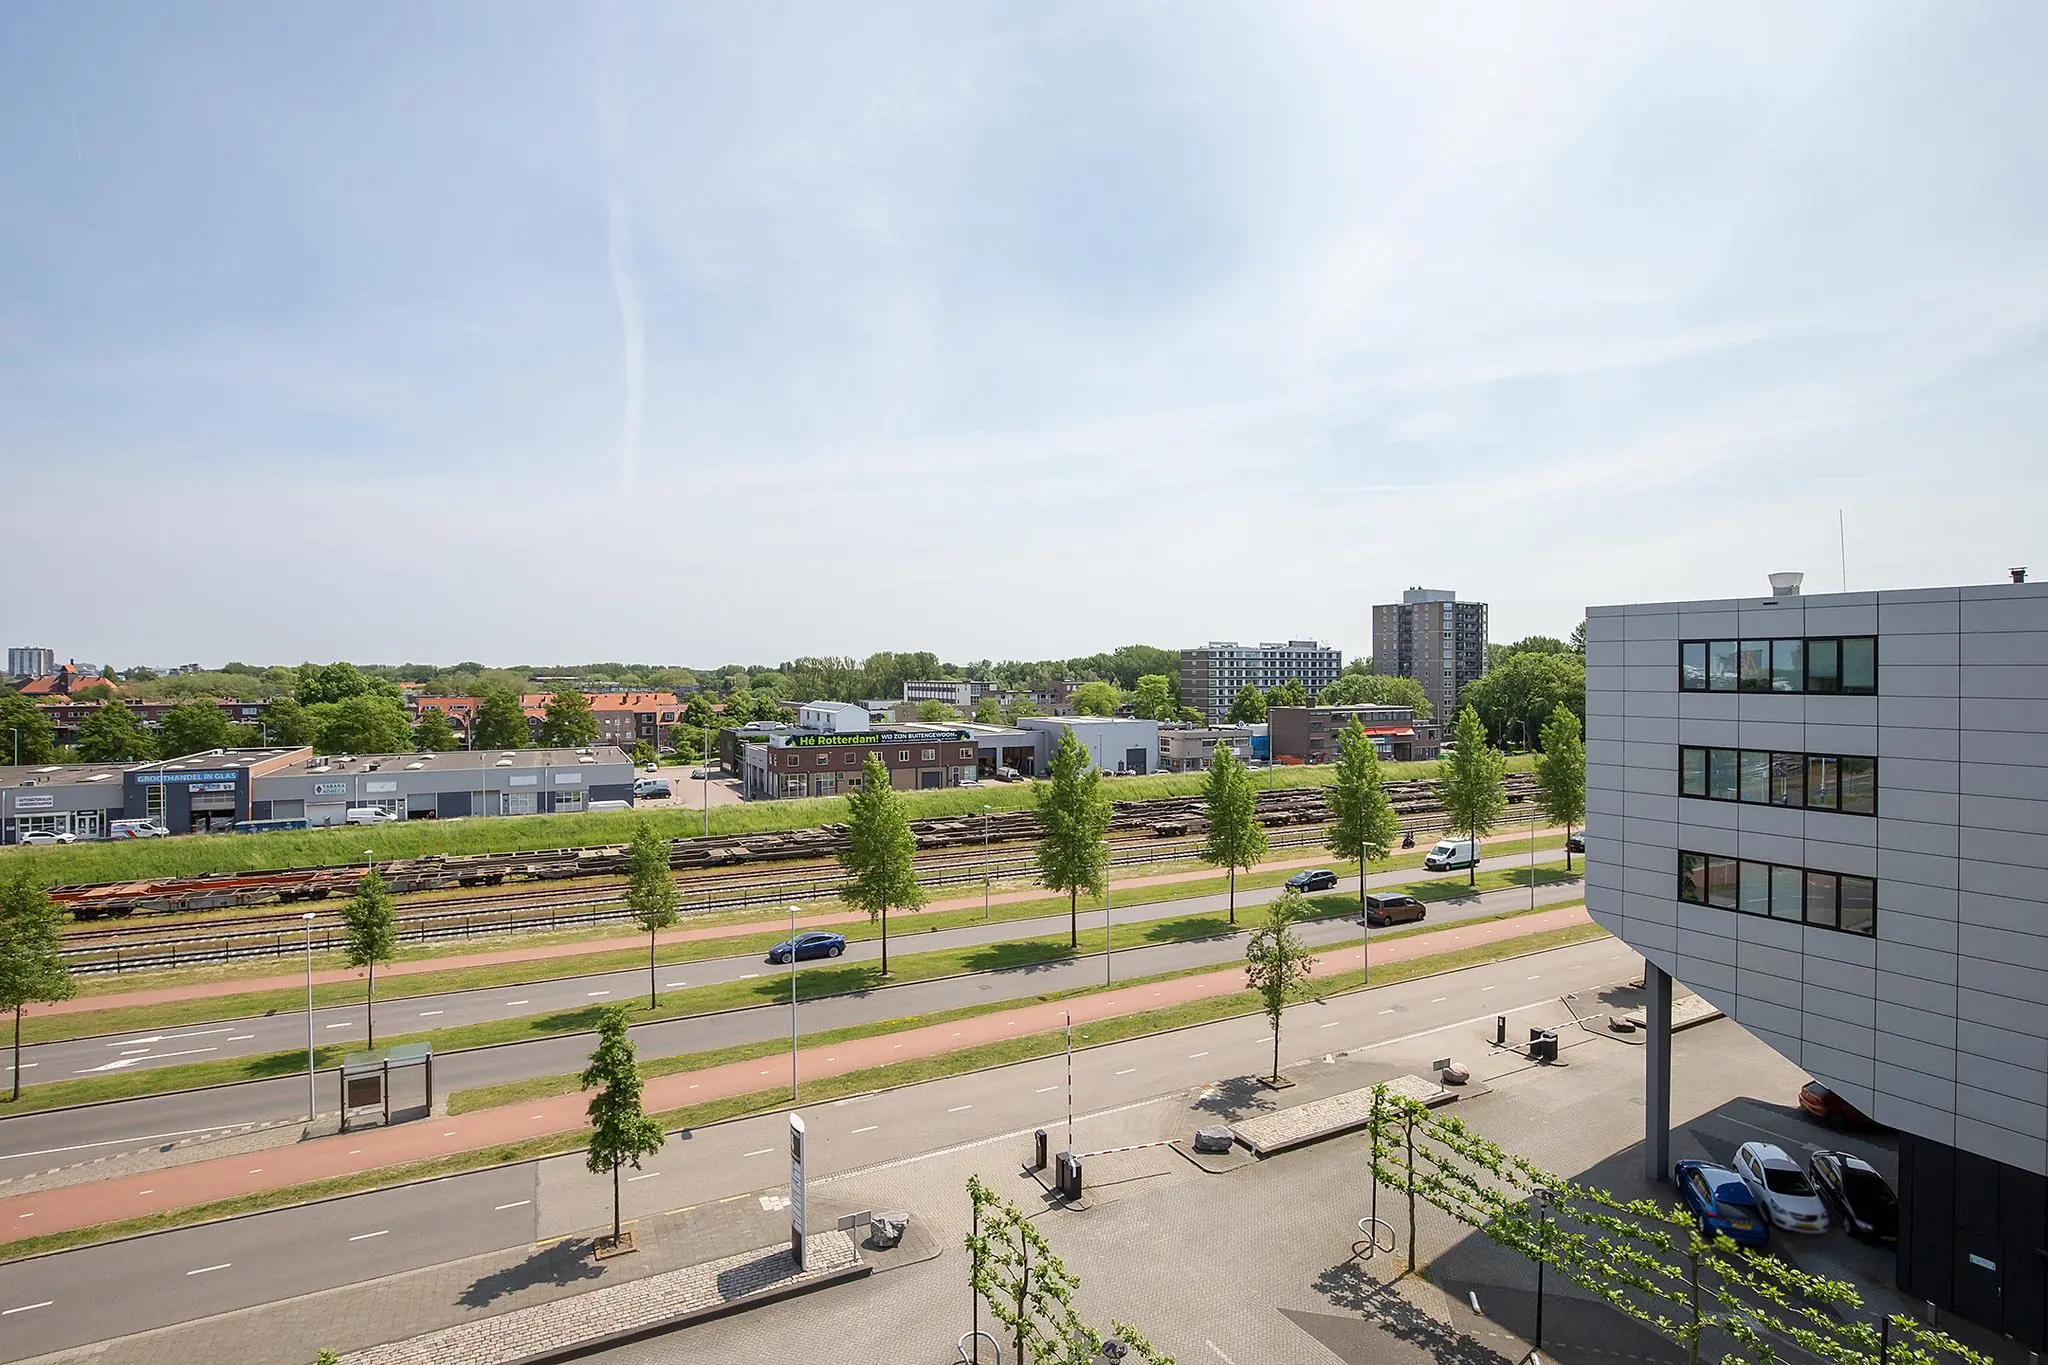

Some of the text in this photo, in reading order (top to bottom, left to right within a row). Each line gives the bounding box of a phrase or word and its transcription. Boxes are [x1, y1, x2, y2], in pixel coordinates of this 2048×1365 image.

[799, 736, 815, 746] Hé
[817, 734, 879, 745] Rotterdam!
[137, 774, 202, 783] GROOTHANDEL
[214, 772, 237, 780] GLAS
